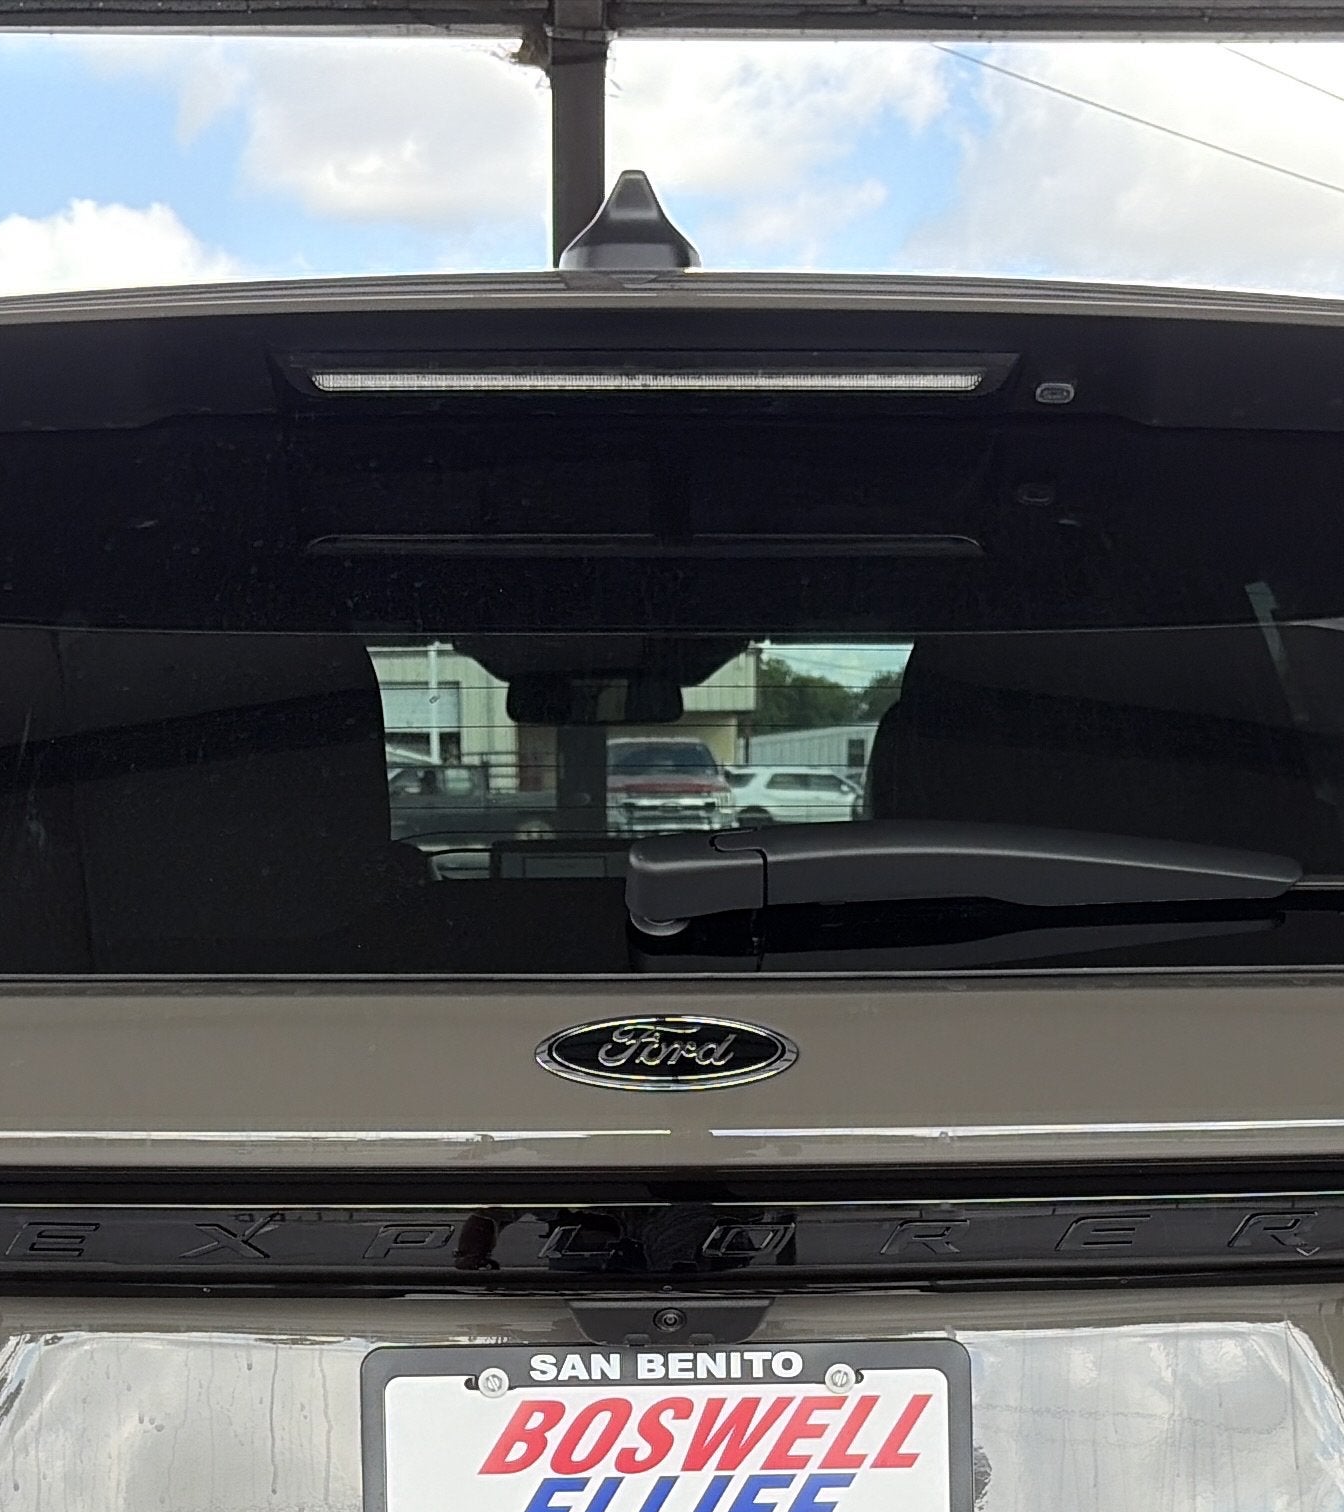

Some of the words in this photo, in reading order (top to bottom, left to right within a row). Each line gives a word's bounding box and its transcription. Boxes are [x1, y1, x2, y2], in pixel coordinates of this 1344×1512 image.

[598, 1025, 736, 1067] Ford
[3, 1211, 1321, 1259] EXPLORER
[529, 1353, 622, 1381] SAN
[637, 1350, 803, 1380] BENITO
[477, 1393, 933, 1475] BOSWELL
